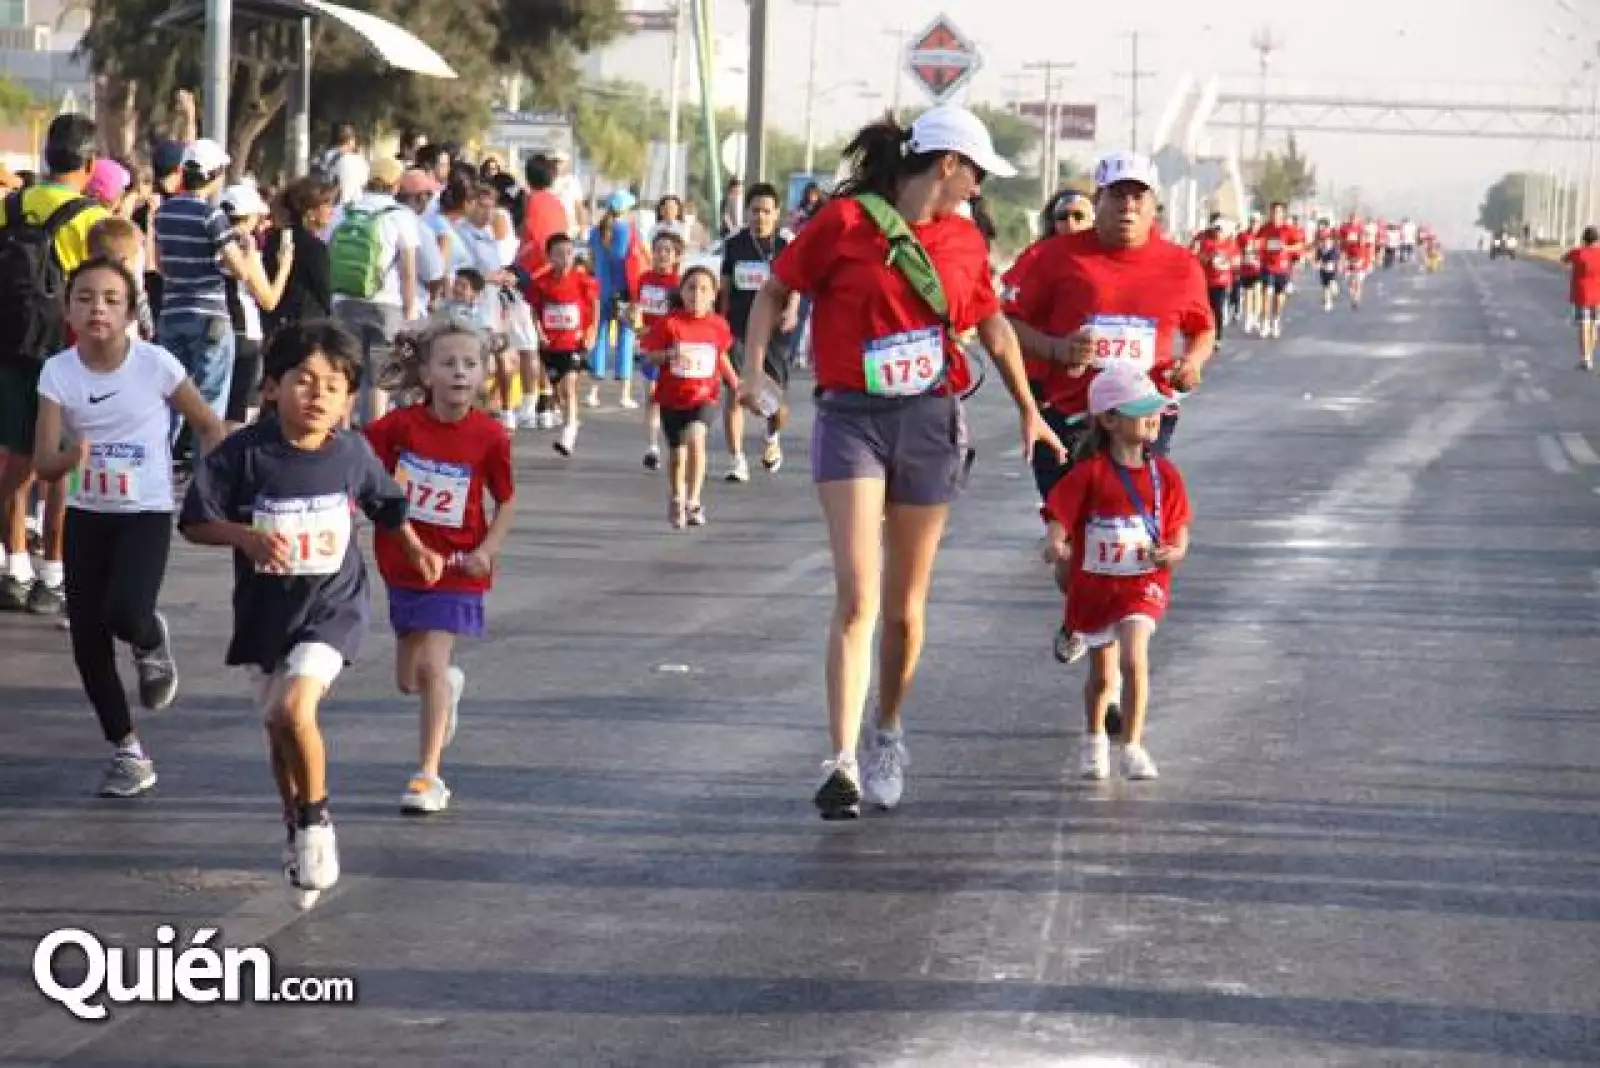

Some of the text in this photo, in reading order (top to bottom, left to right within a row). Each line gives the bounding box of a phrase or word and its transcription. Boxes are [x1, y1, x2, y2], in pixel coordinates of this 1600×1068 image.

[1095, 338, 1142, 358] 875
[881, 354, 933, 386] 173
[83, 467, 128, 496] 111
[405, 480, 454, 513] 172
[296, 530, 336, 560] 13
